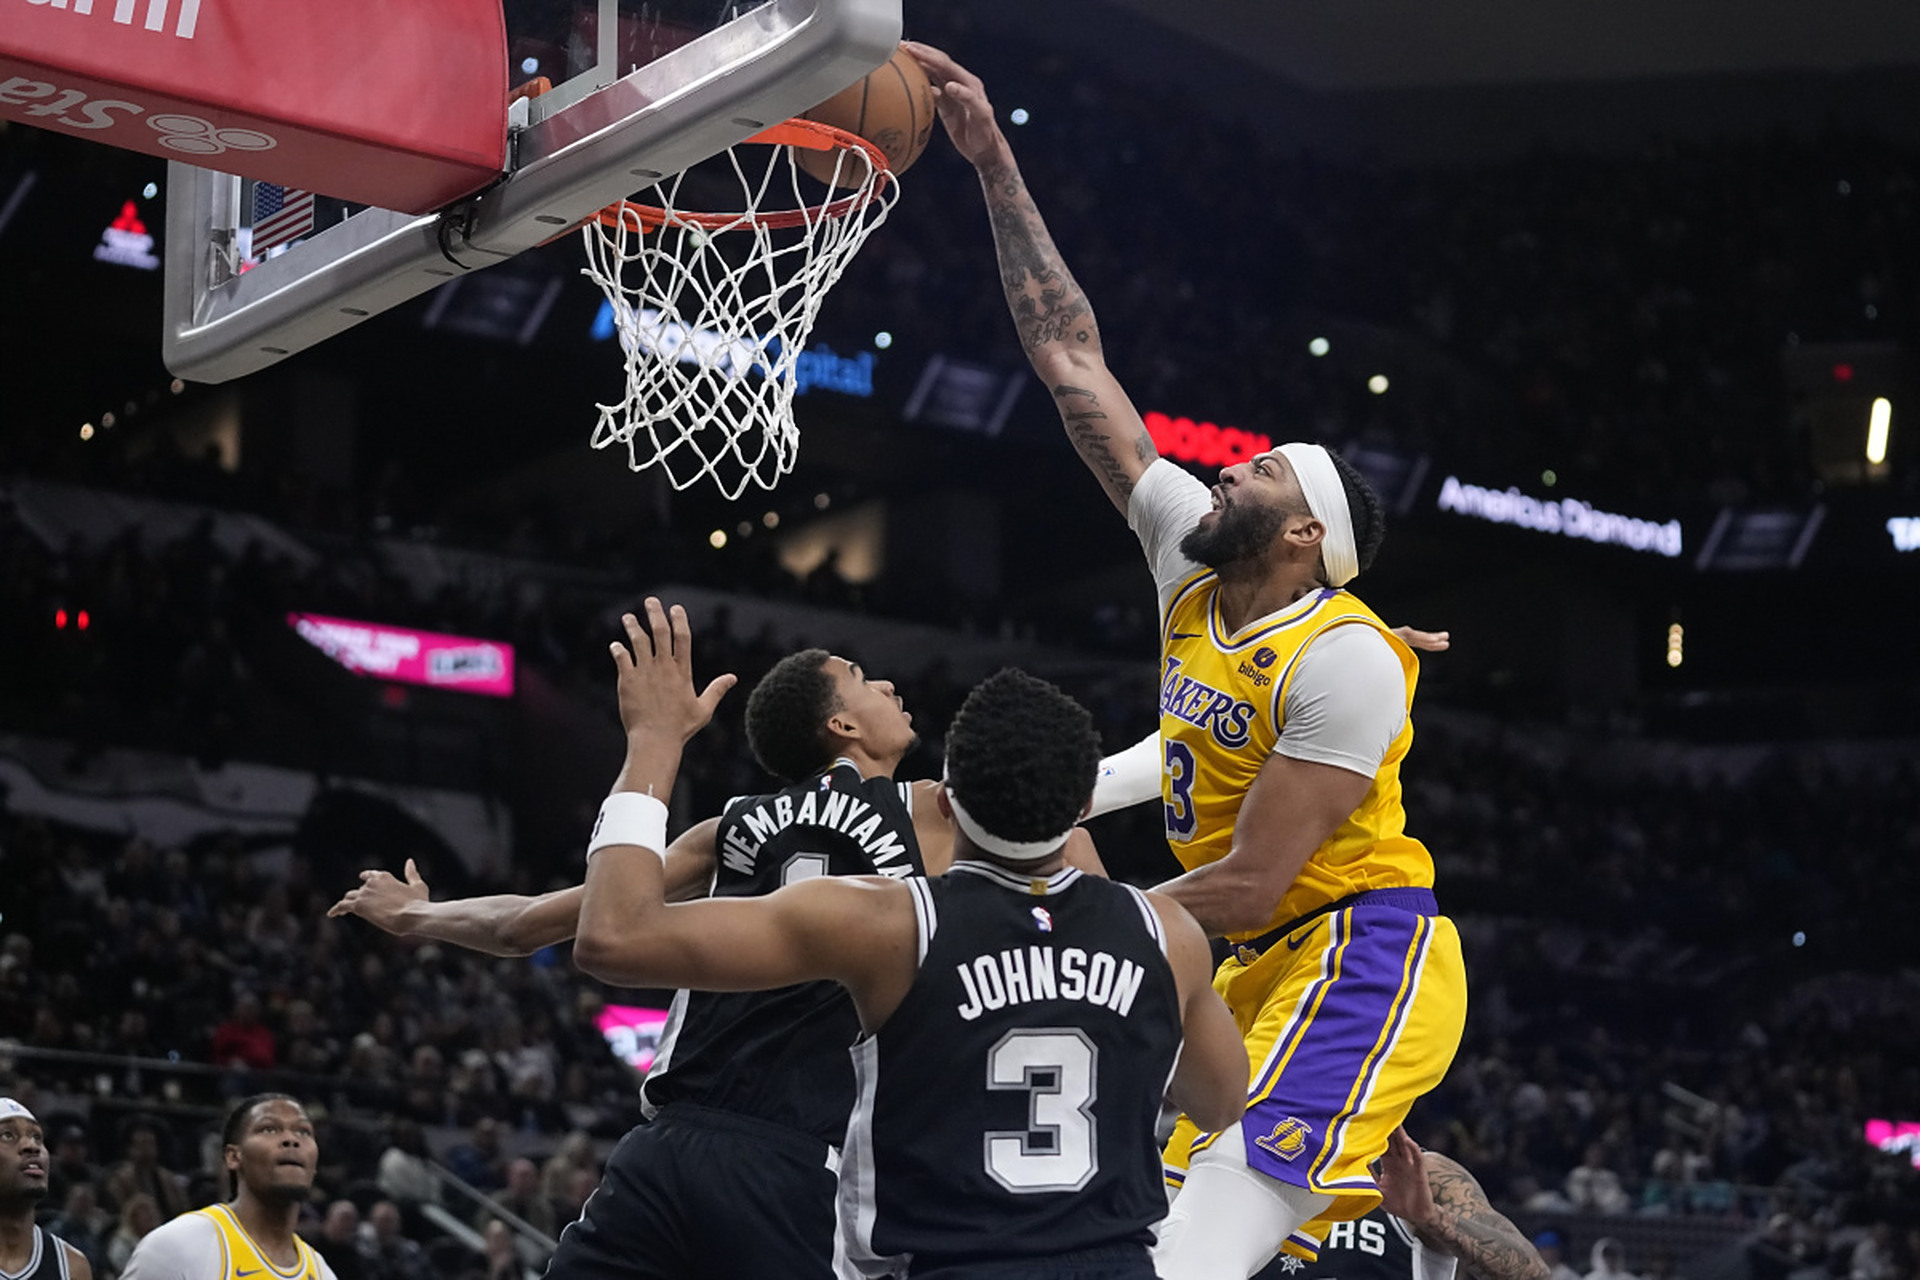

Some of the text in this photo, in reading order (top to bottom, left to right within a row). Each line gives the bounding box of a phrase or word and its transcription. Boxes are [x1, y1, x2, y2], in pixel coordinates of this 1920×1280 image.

[1561, 497, 1682, 558] Diamond
[1238, 661, 1271, 688] bibigo
[723, 790, 914, 880] WEMBANYAMA
[957, 946, 1145, 1021] JOHNSON
[983, 1027, 1099, 1194] 3
